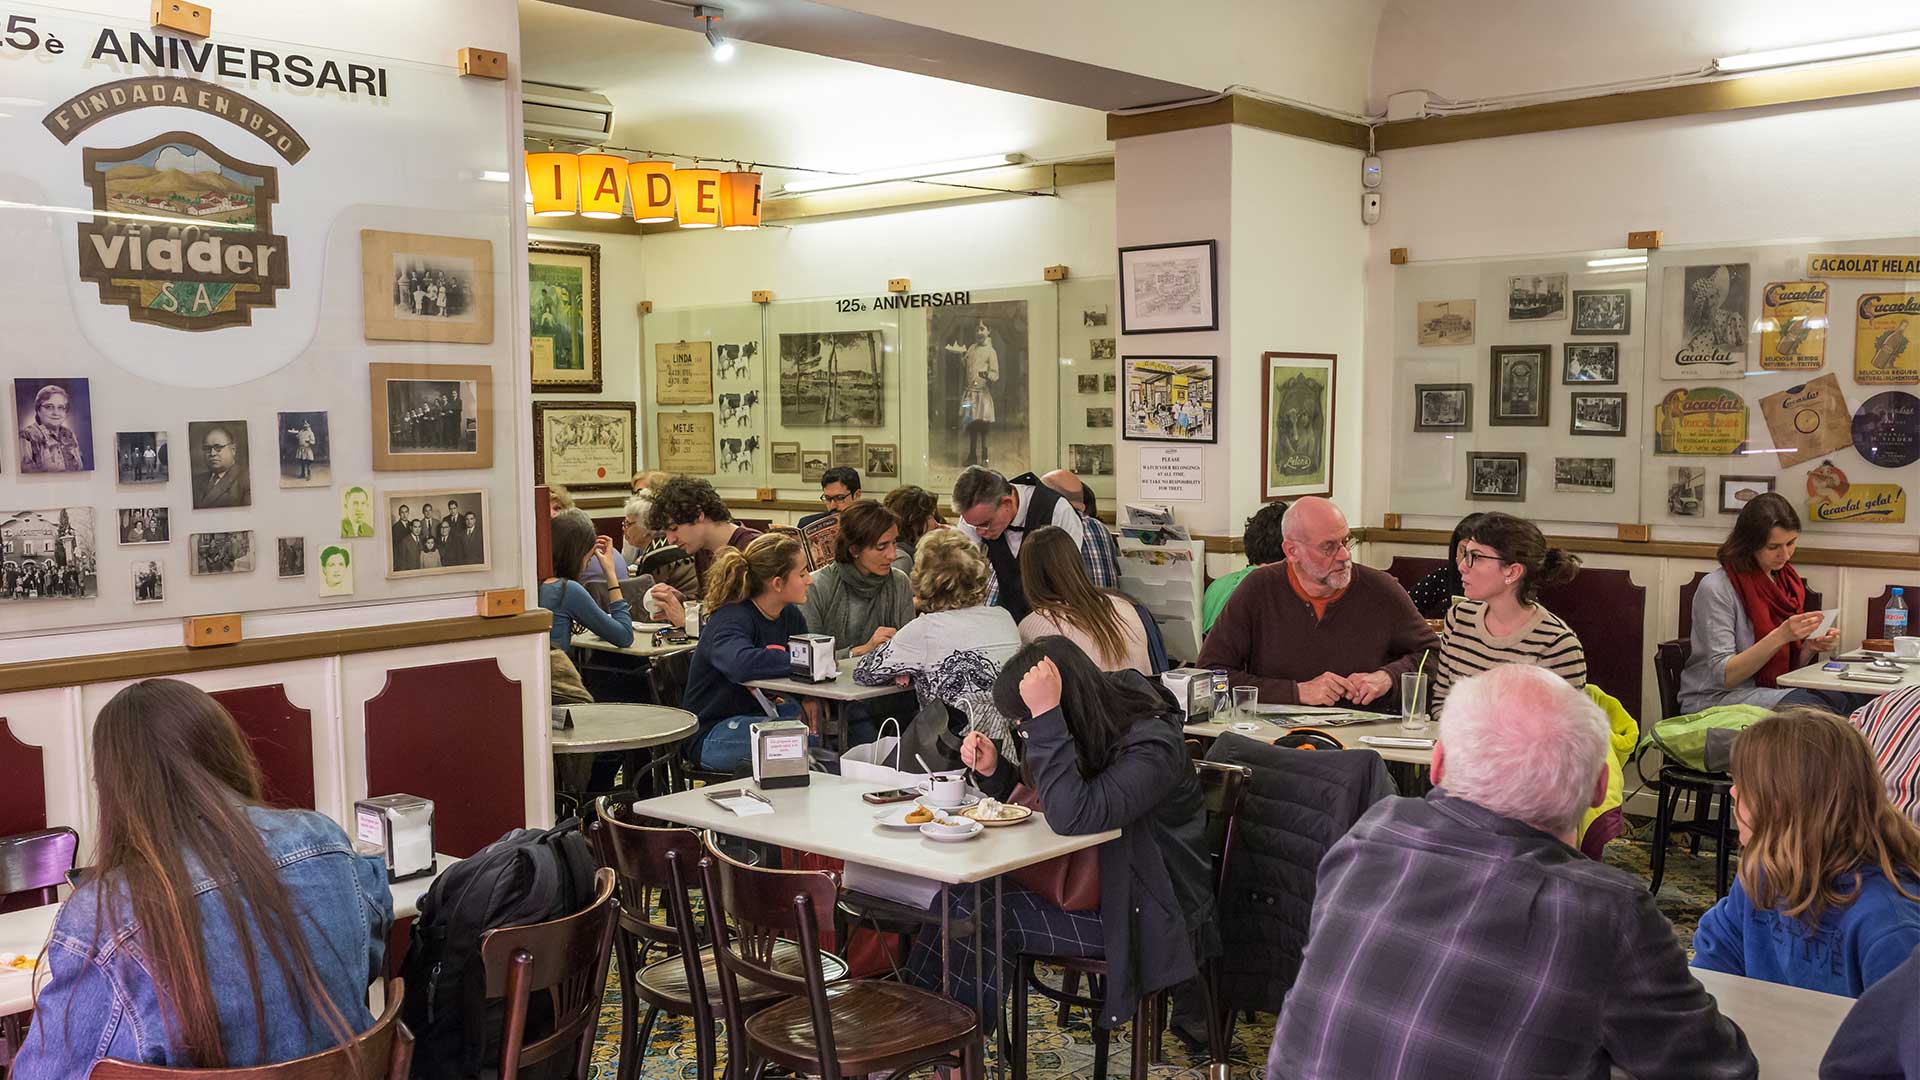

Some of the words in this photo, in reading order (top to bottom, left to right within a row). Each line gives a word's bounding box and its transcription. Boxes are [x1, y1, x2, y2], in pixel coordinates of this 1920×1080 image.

[0, 14, 64, 54] 5è
[91, 27, 388, 98] ANIVERSARI
[54, 84, 189, 131] FUNDADA
[238, 107, 293, 153] 1870
[1812, 258, 1879, 272] CACAOLAT
[835, 298, 867, 313] 125è
[873, 290, 971, 310] ANIVERSARI
[1765, 284, 1826, 307] Cacaolat
[672, 353, 693, 364] LINDA
[1675, 348, 1739, 365] Cacaolat
[672, 423, 694, 433] METJE
[1818, 500, 1860, 519] Cacaolat
